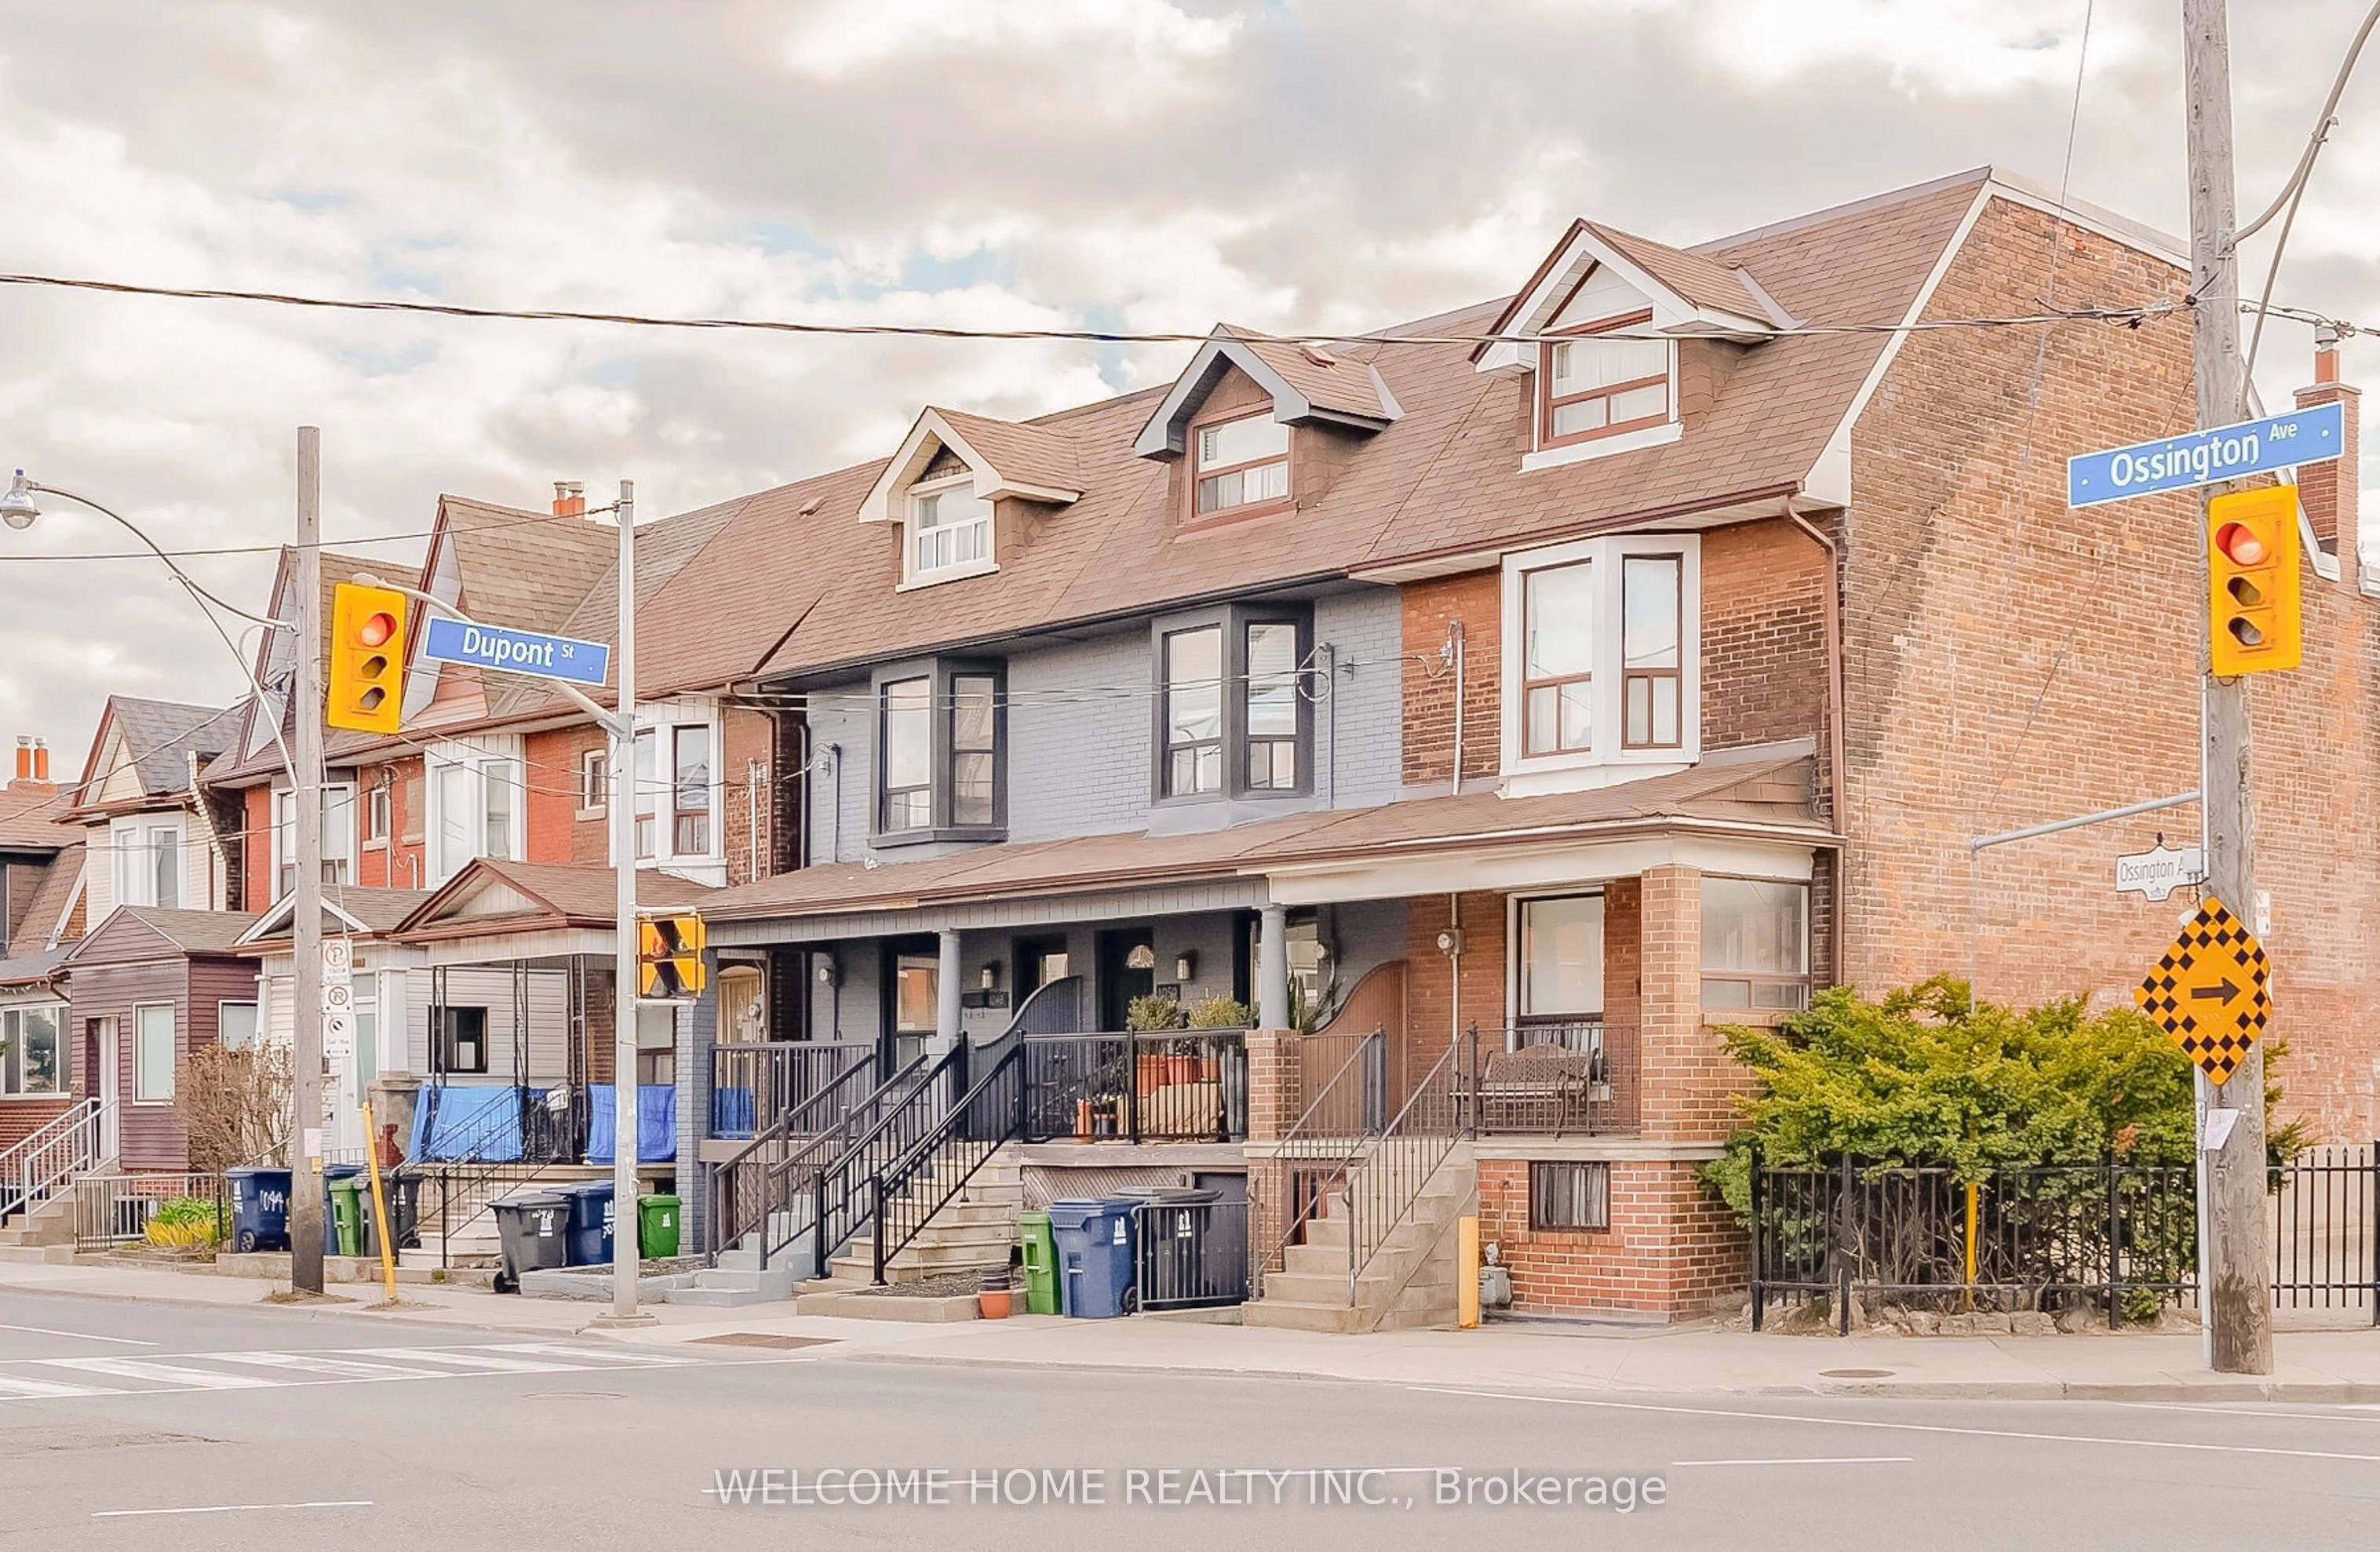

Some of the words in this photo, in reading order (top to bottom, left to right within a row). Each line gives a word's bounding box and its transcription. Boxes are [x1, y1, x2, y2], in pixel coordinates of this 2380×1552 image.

[2110, 435, 2259, 487] Ossington
[2268, 422, 2298, 442] Ave
[462, 627, 554, 667] Dupont
[561, 643, 576, 659] St
[2120, 860, 2174, 884] Ossington
